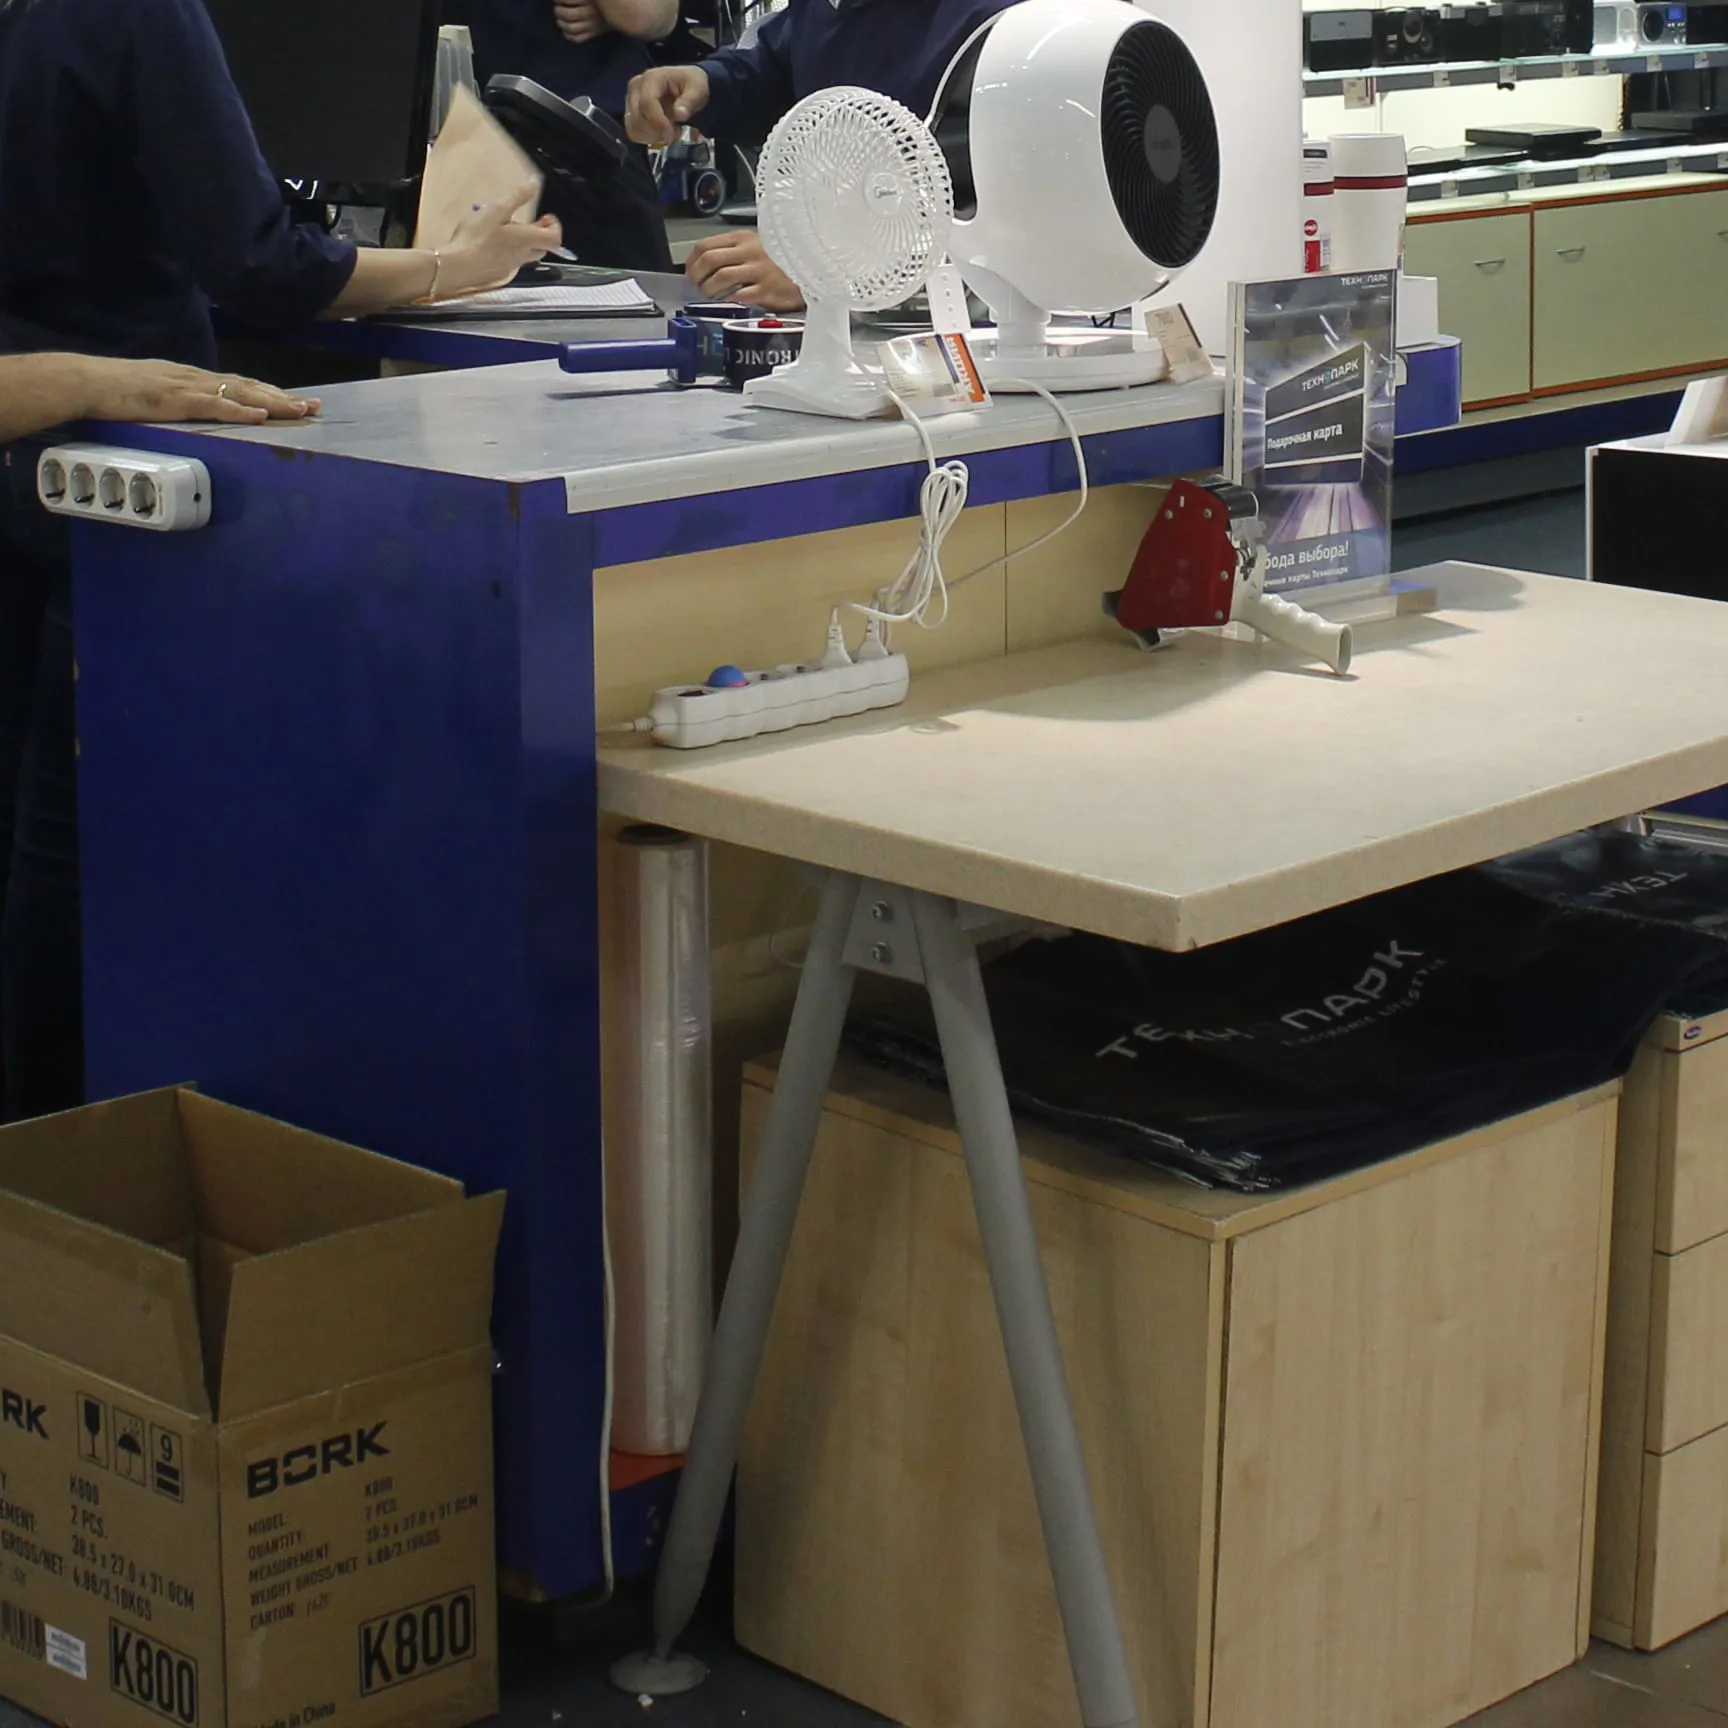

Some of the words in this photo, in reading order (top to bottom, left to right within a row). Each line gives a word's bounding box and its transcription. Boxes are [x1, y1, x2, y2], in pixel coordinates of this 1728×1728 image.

[735, 349, 800, 366] RONIC
[1266, 430, 1312, 451] Подарочная
[1313, 423, 1344, 442] карта
[1264, 552, 1296, 570] бода
[1299, 540, 1349, 565] выбора!
[1096, 939, 1426, 1061] ТЕХНПАРК
[160, 1432, 174, 1462] 9
[247, 1420, 391, 1500] BORK
[363, 1593, 472, 1691] K800
[112, 1624, 195, 1725] K800
[303, 1702, 337, 1724] China
